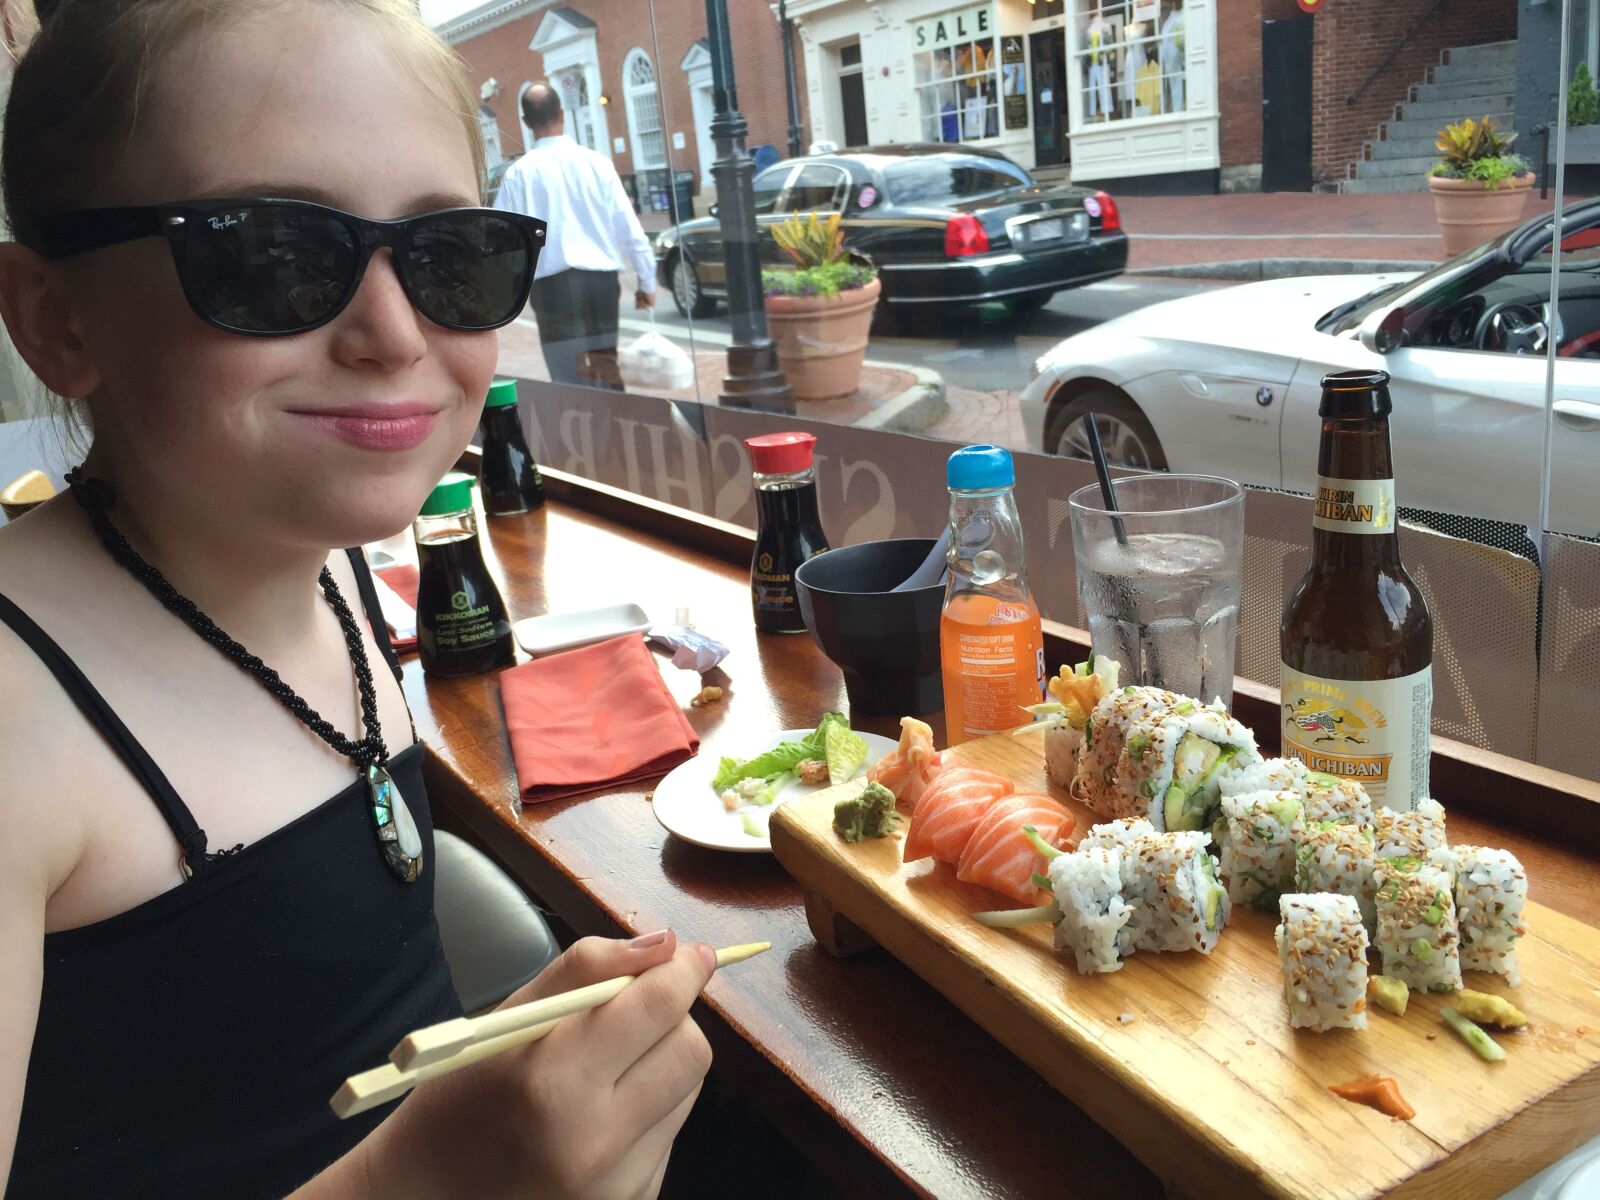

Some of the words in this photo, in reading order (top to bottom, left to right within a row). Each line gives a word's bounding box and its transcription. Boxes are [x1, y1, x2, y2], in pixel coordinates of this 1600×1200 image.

[916, 9, 988, 46] SALE
[1320, 486, 1355, 504] KIRIN
[460, 629, 495, 643] Sauce
[960, 643, 991, 654] Nutrition
[994, 645, 1014, 653] Facts
[1303, 680, 1348, 701] PRIME
[1311, 756, 1384, 776] ICHIBAN
